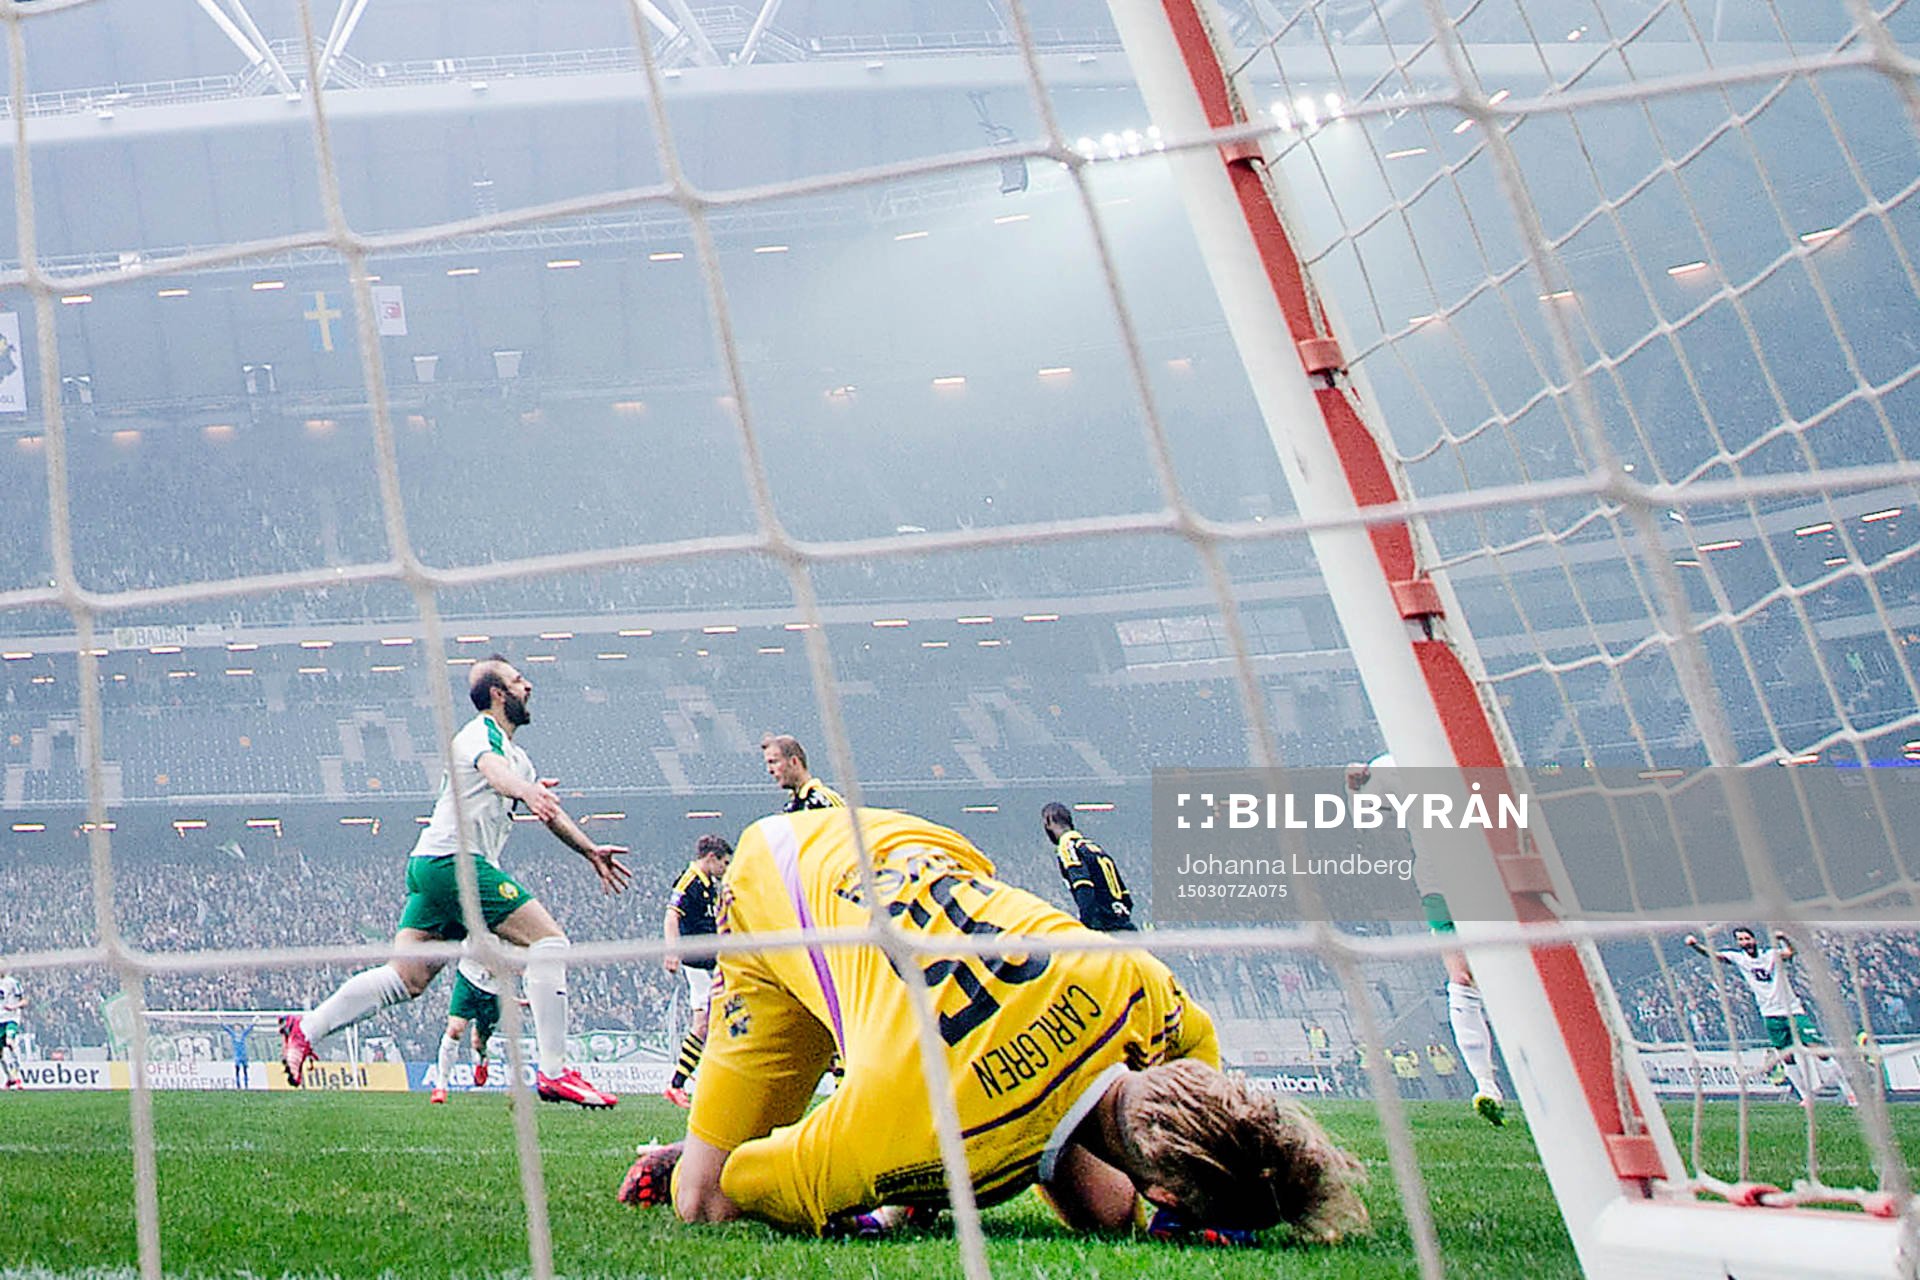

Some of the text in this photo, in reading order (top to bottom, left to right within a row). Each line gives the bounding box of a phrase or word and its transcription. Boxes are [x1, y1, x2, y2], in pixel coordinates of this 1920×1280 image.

[971, 984, 1101, 1098] CARLGREN
[20, 1063, 100, 1084] weber
[145, 1062, 198, 1076] OFFICE
